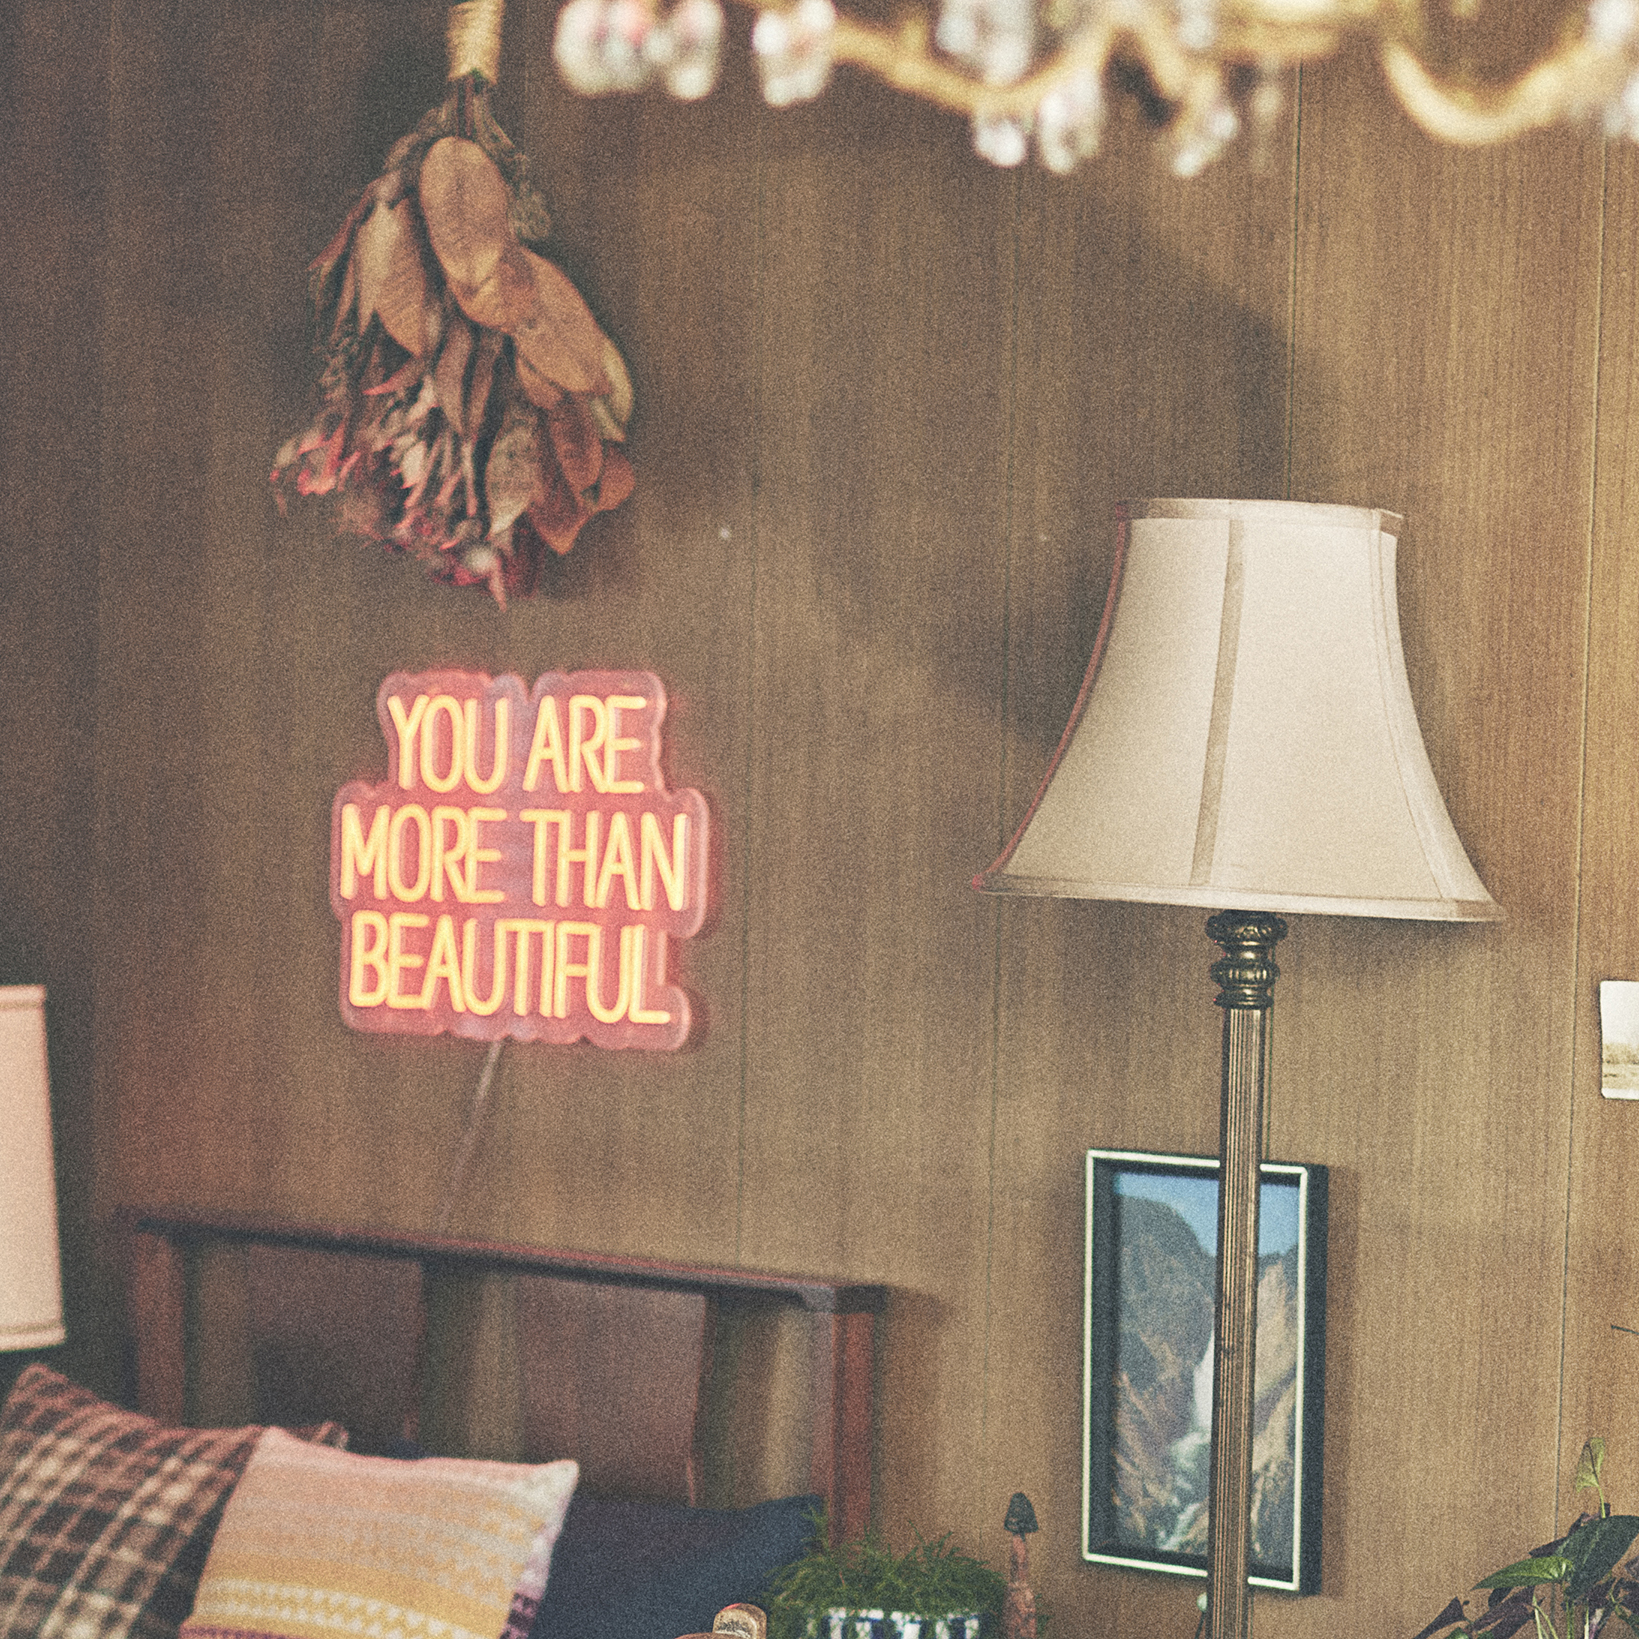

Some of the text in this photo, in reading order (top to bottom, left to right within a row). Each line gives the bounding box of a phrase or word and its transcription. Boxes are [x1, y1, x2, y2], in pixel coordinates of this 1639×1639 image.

[386, 694, 647, 794] YOU ARE
[339, 803, 690, 912] MORE THAN
[348, 910, 671, 1024] BEAUTIFUL
